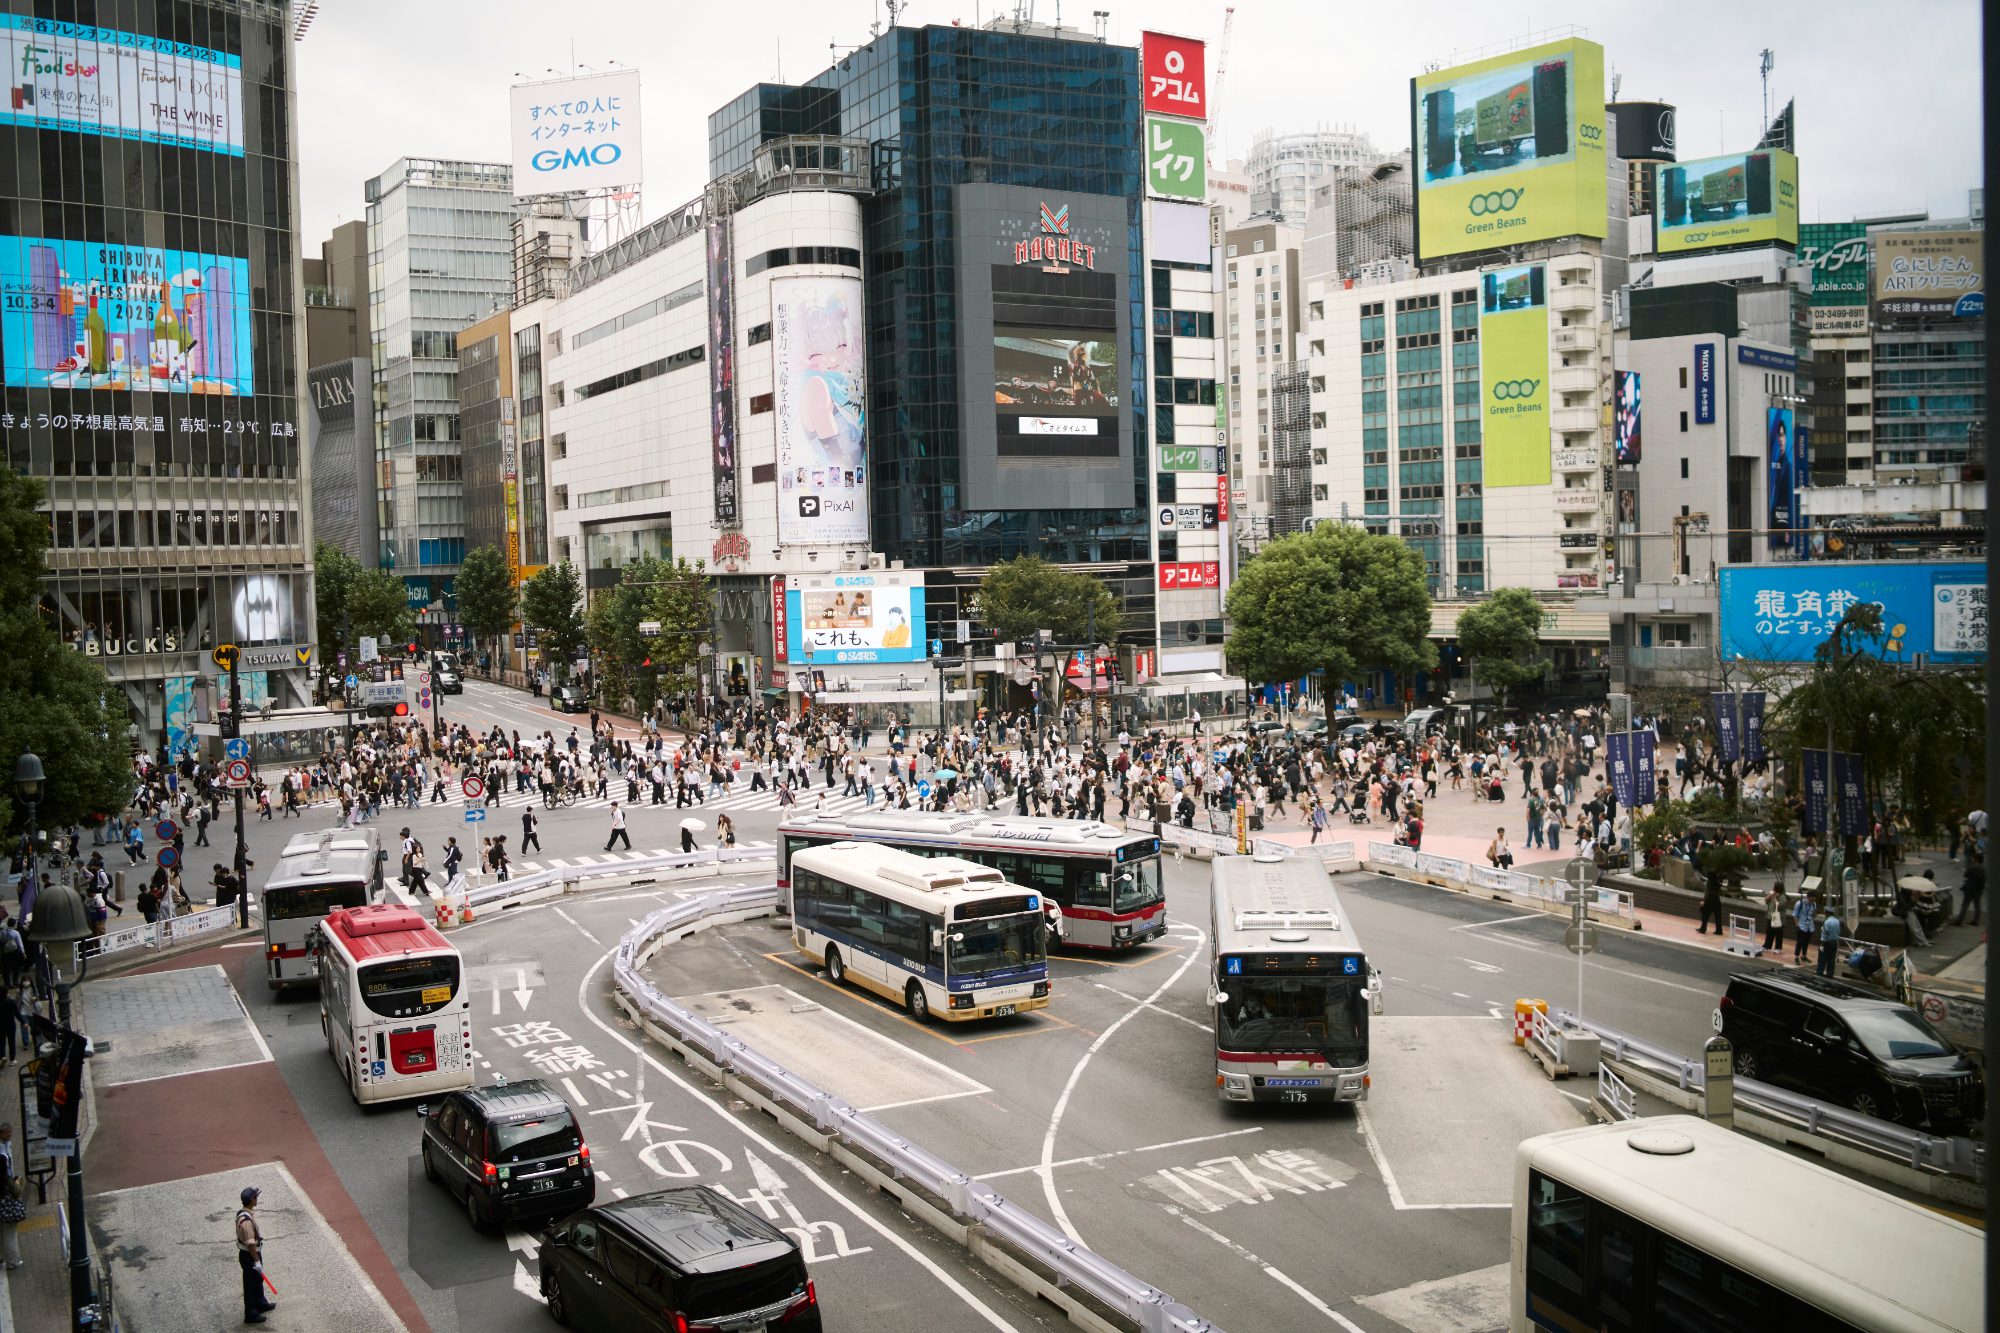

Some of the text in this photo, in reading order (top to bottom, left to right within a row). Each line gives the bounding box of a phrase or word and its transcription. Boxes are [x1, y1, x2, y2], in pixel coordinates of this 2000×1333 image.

[1150, 75, 1200, 104] アコム
[150, 102, 223, 128] THE WINE
[530, 95, 621, 121] すべての人に
[531, 117, 621, 141] インターネット
[531, 142, 622, 172] GMO
[1228, 182, 1248, 193] HOTEL
[1465, 214, 1527, 234] Green Beans
[1733, 226, 1750, 235] Beans
[100, 249, 162, 269] SHIBUYA
[1015, 236, 1095, 270] MAGNET
[1800, 237, 1867, 271] エイブル
[1912, 256, 1971, 272] にしたん
[104, 268, 159, 286] FRENCH
[1884, 273, 1980, 290] ARTクリニック
[6, 295, 57, 309] 10.3-4
[100, 285, 167, 304] FESTIVAL
[116, 303, 154, 321] 2026
[1701, 349, 1709, 382] MIZUHO
[312, 375, 355, 409] ZARA
[1490, 401, 1542, 416] Green Beans
[1, 413, 165, 432] きょうの予想最高気温
[1163, 449, 1197, 465] レイク
[1204, 459, 1213, 469] 5F
[1556, 453, 1577, 461] DARTS
[824, 499, 854, 512] PixAI
[1178, 508, 1200, 516] EAST
[713, 532, 751, 565] MAGNET
[1164, 568, 1202, 583] アコム
[1205, 564, 1216, 574] 3F
[845, 576, 876, 586] STARTS
[775, 594, 785, 655] 天津甘栗
[814, 630, 870, 646] これも、
[246, 653, 292, 665] TSUTAYA
[847, 651, 877, 661] STARTS
[368, 686, 403, 697] 渋谷駅前
[1614, 760, 1625, 774] 祭
[1639, 757, 1649, 771] 祭
[991, 830, 1051, 842] Hybrid
[1833, 851, 1845, 867] 29
[903, 957, 926, 974] KEIO BUS
[368, 984, 387, 992] 6804
[960, 982, 974, 990] KEIO
[999, 1007, 1015, 1017] 23-86
[1713, 1013, 1722, 1027] 21
[1290, 1093, 1308, 1102] 175
[540, 1180, 554, 1190] 193
